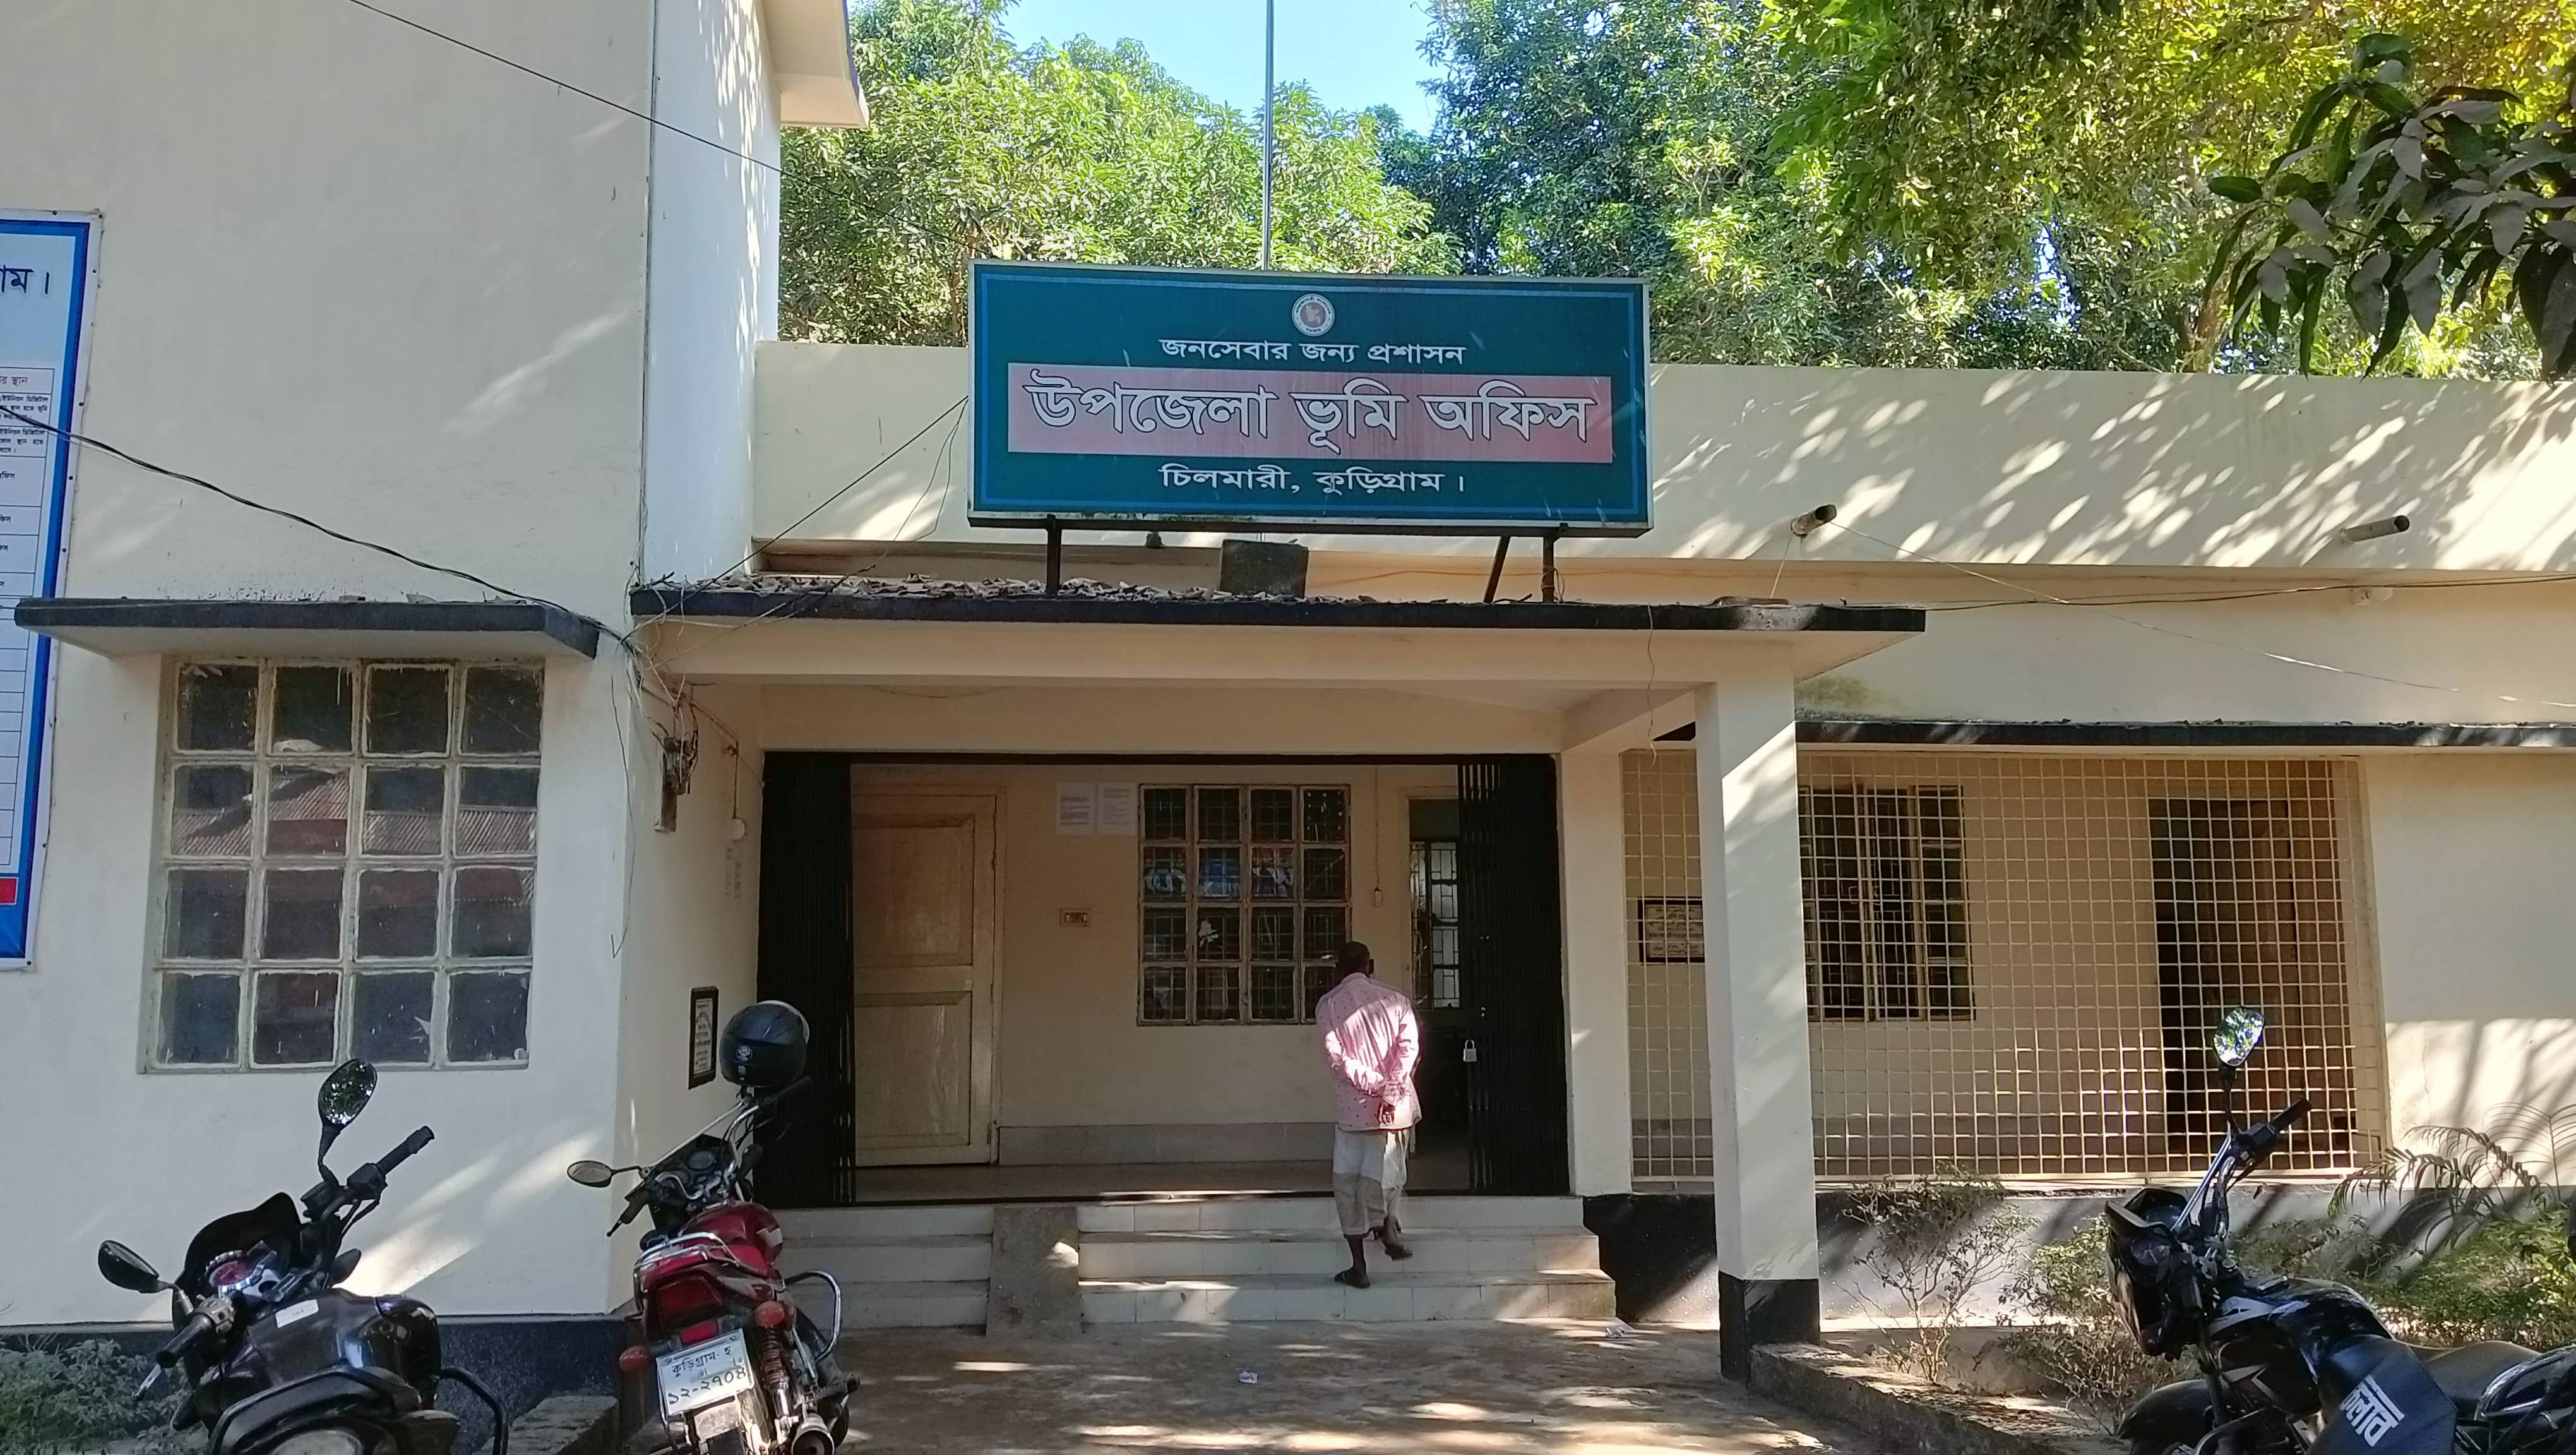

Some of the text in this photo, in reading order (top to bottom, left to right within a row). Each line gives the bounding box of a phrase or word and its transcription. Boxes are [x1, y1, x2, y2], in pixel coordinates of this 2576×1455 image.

[1159, 339, 1467, 364] জনসেবার জন্য প্রশাসন
[1022, 369, 1598, 455] উপজেলা ভূমি অফিস
[1158, 463, 1301, 494] চিলমারী,
[1312, 466, 1446, 496] কুড়িগ্রাম
